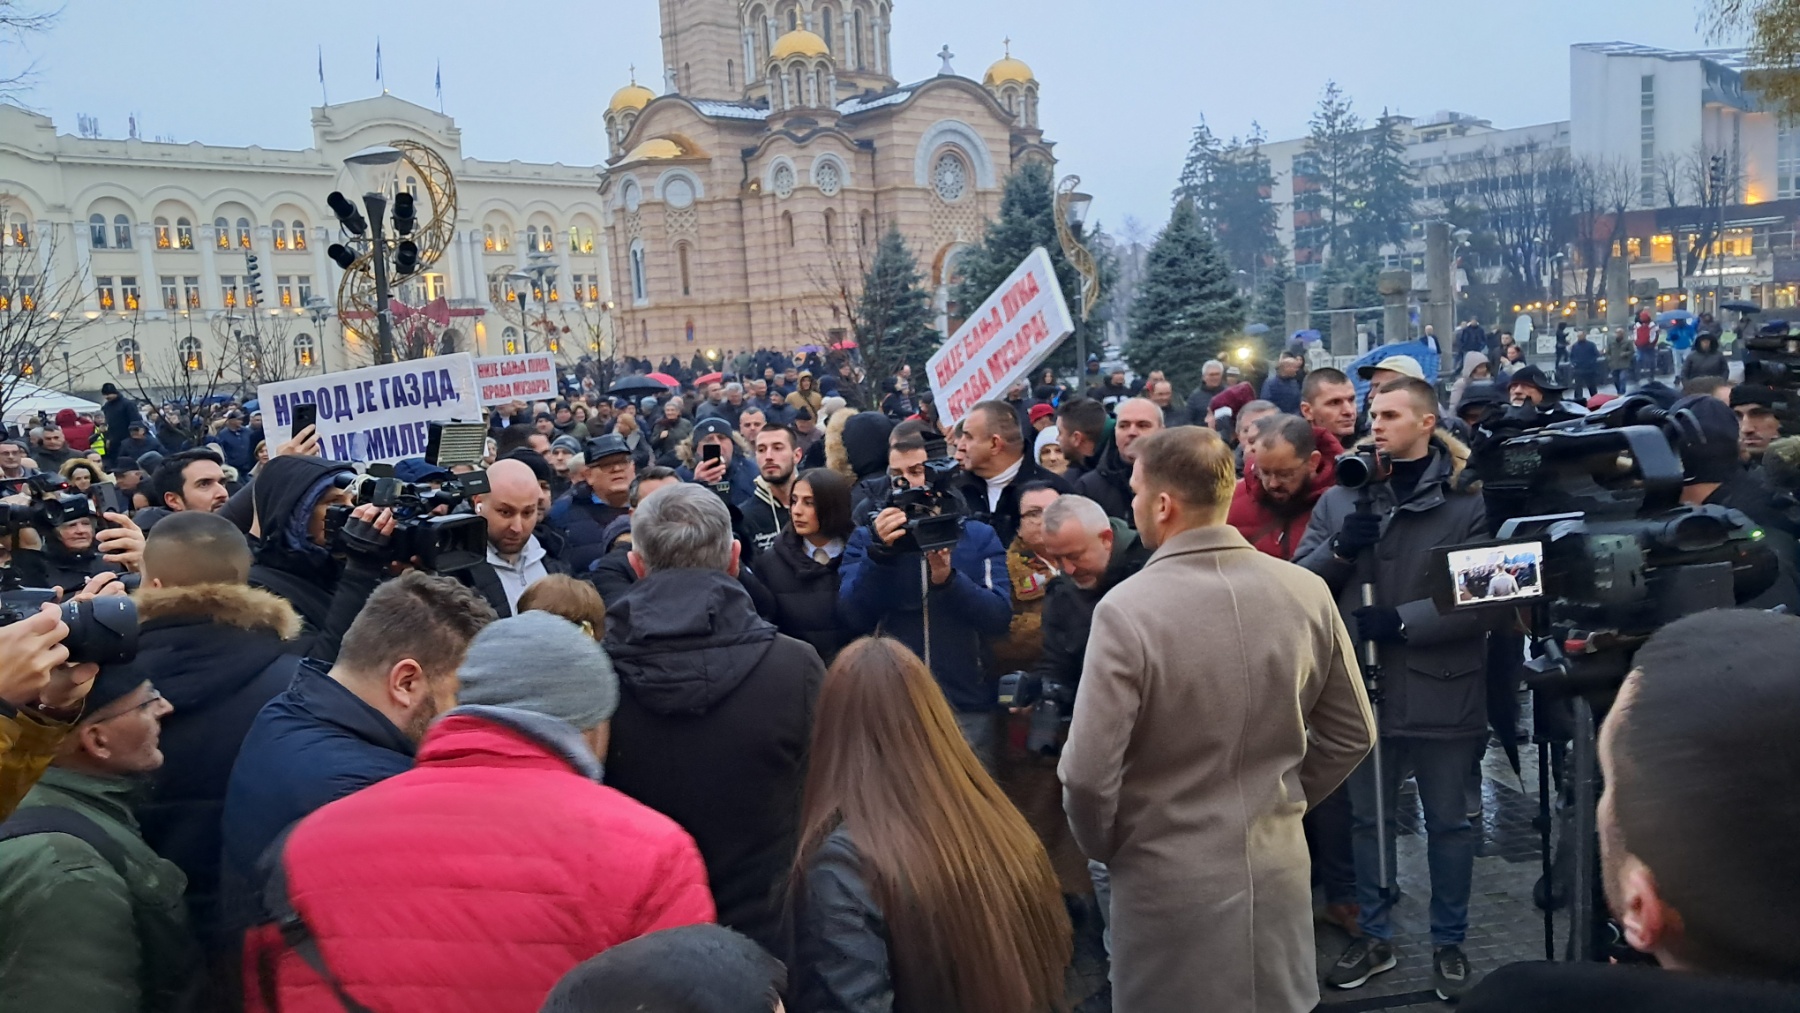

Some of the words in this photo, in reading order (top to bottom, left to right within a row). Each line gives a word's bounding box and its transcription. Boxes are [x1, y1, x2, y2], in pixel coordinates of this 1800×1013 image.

[934, 344, 964, 388] НИЈЕ
[963, 306, 1003, 360] БАЊА
[355, 380, 378, 414] ЈЕ
[379, 369, 460, 410] ГАЗДА,
